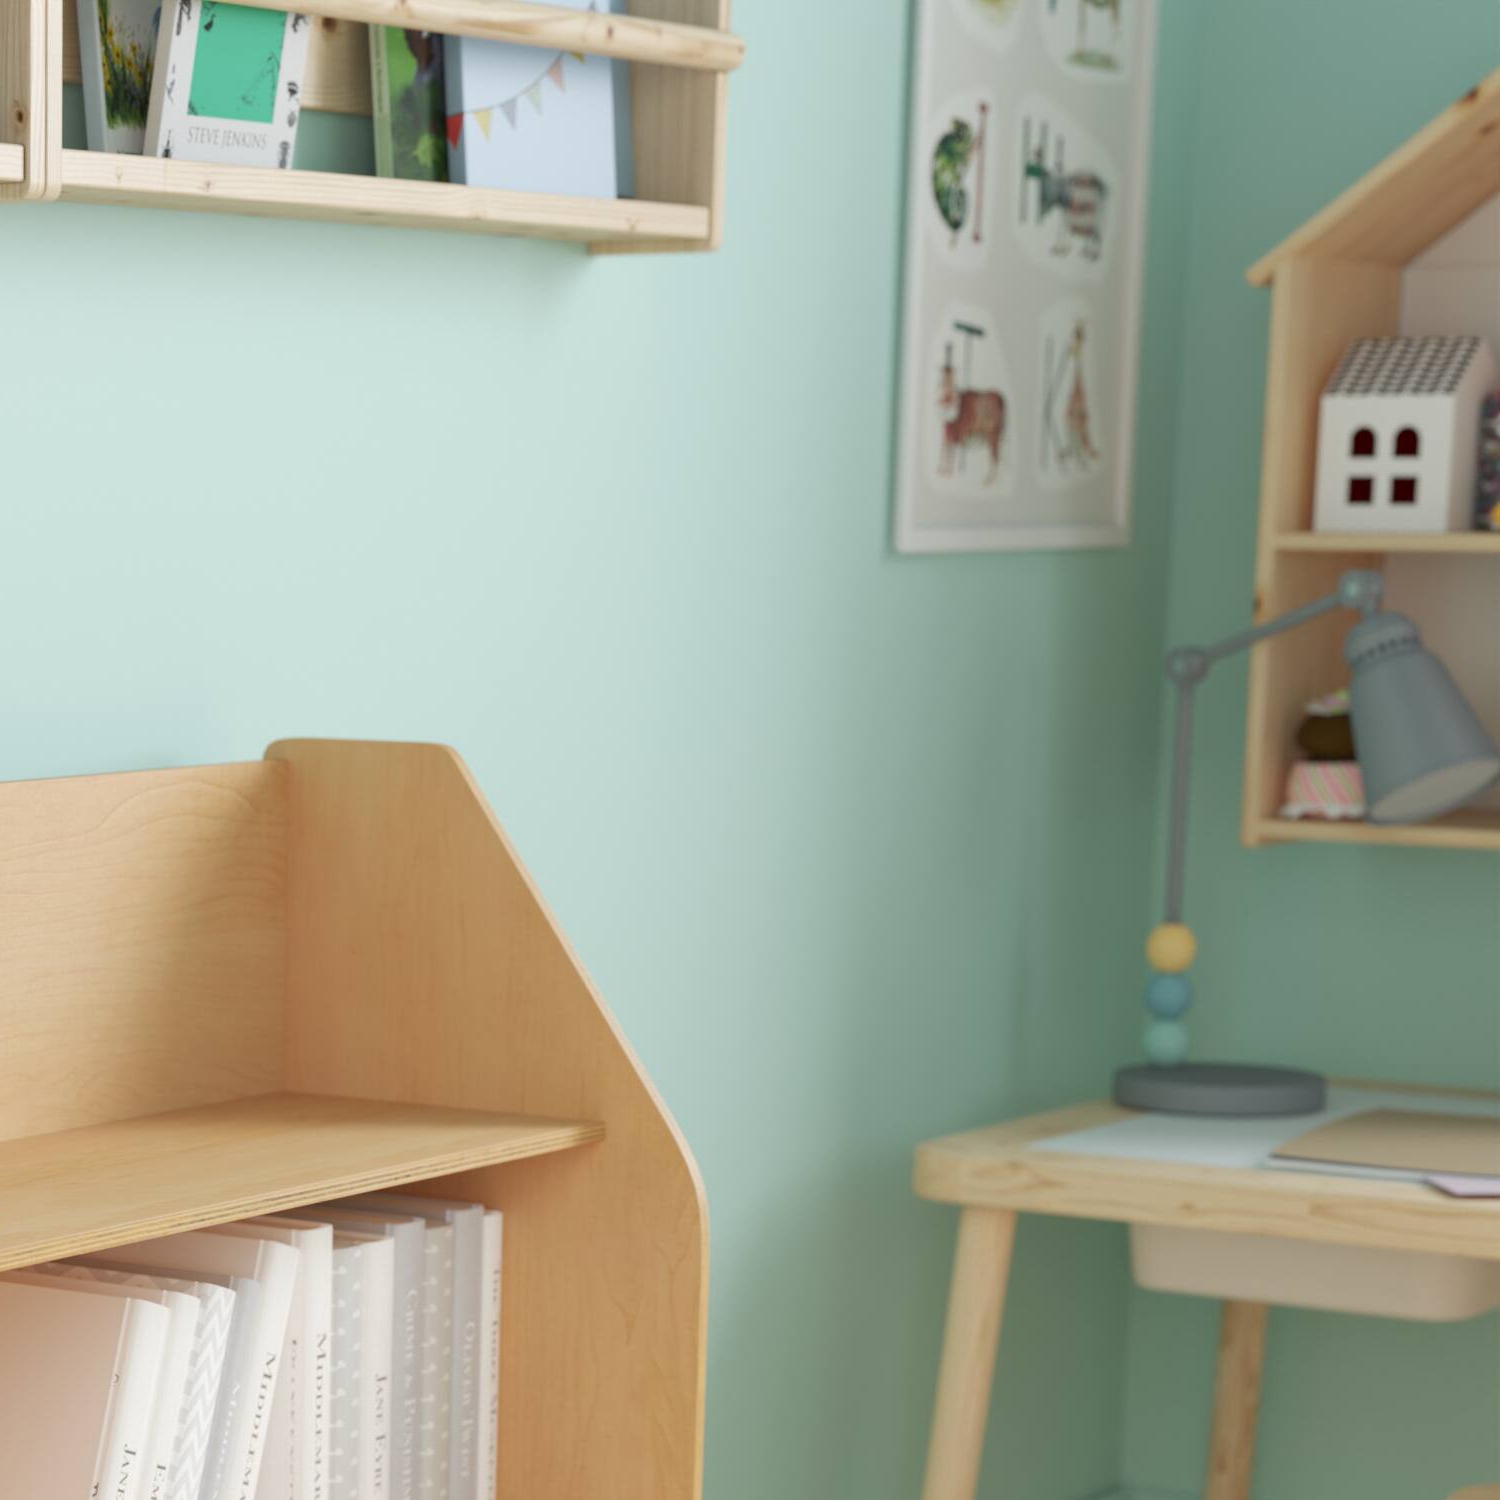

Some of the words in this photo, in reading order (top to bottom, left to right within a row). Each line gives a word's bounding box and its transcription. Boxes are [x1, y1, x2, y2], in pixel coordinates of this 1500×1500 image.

[187, 126, 220, 146] STEVE
[220, 129, 268, 149] JENKINS
[405, 1288, 418, 1361] CRIME
[462, 1320, 476, 1405] OLIVER
[374, 1372, 388, 1426] JANE
[115, 1443, 137, 1500] JANE
[373, 1432, 386, 1494] EYRE
[460, 1417, 475, 1478] TWIST
